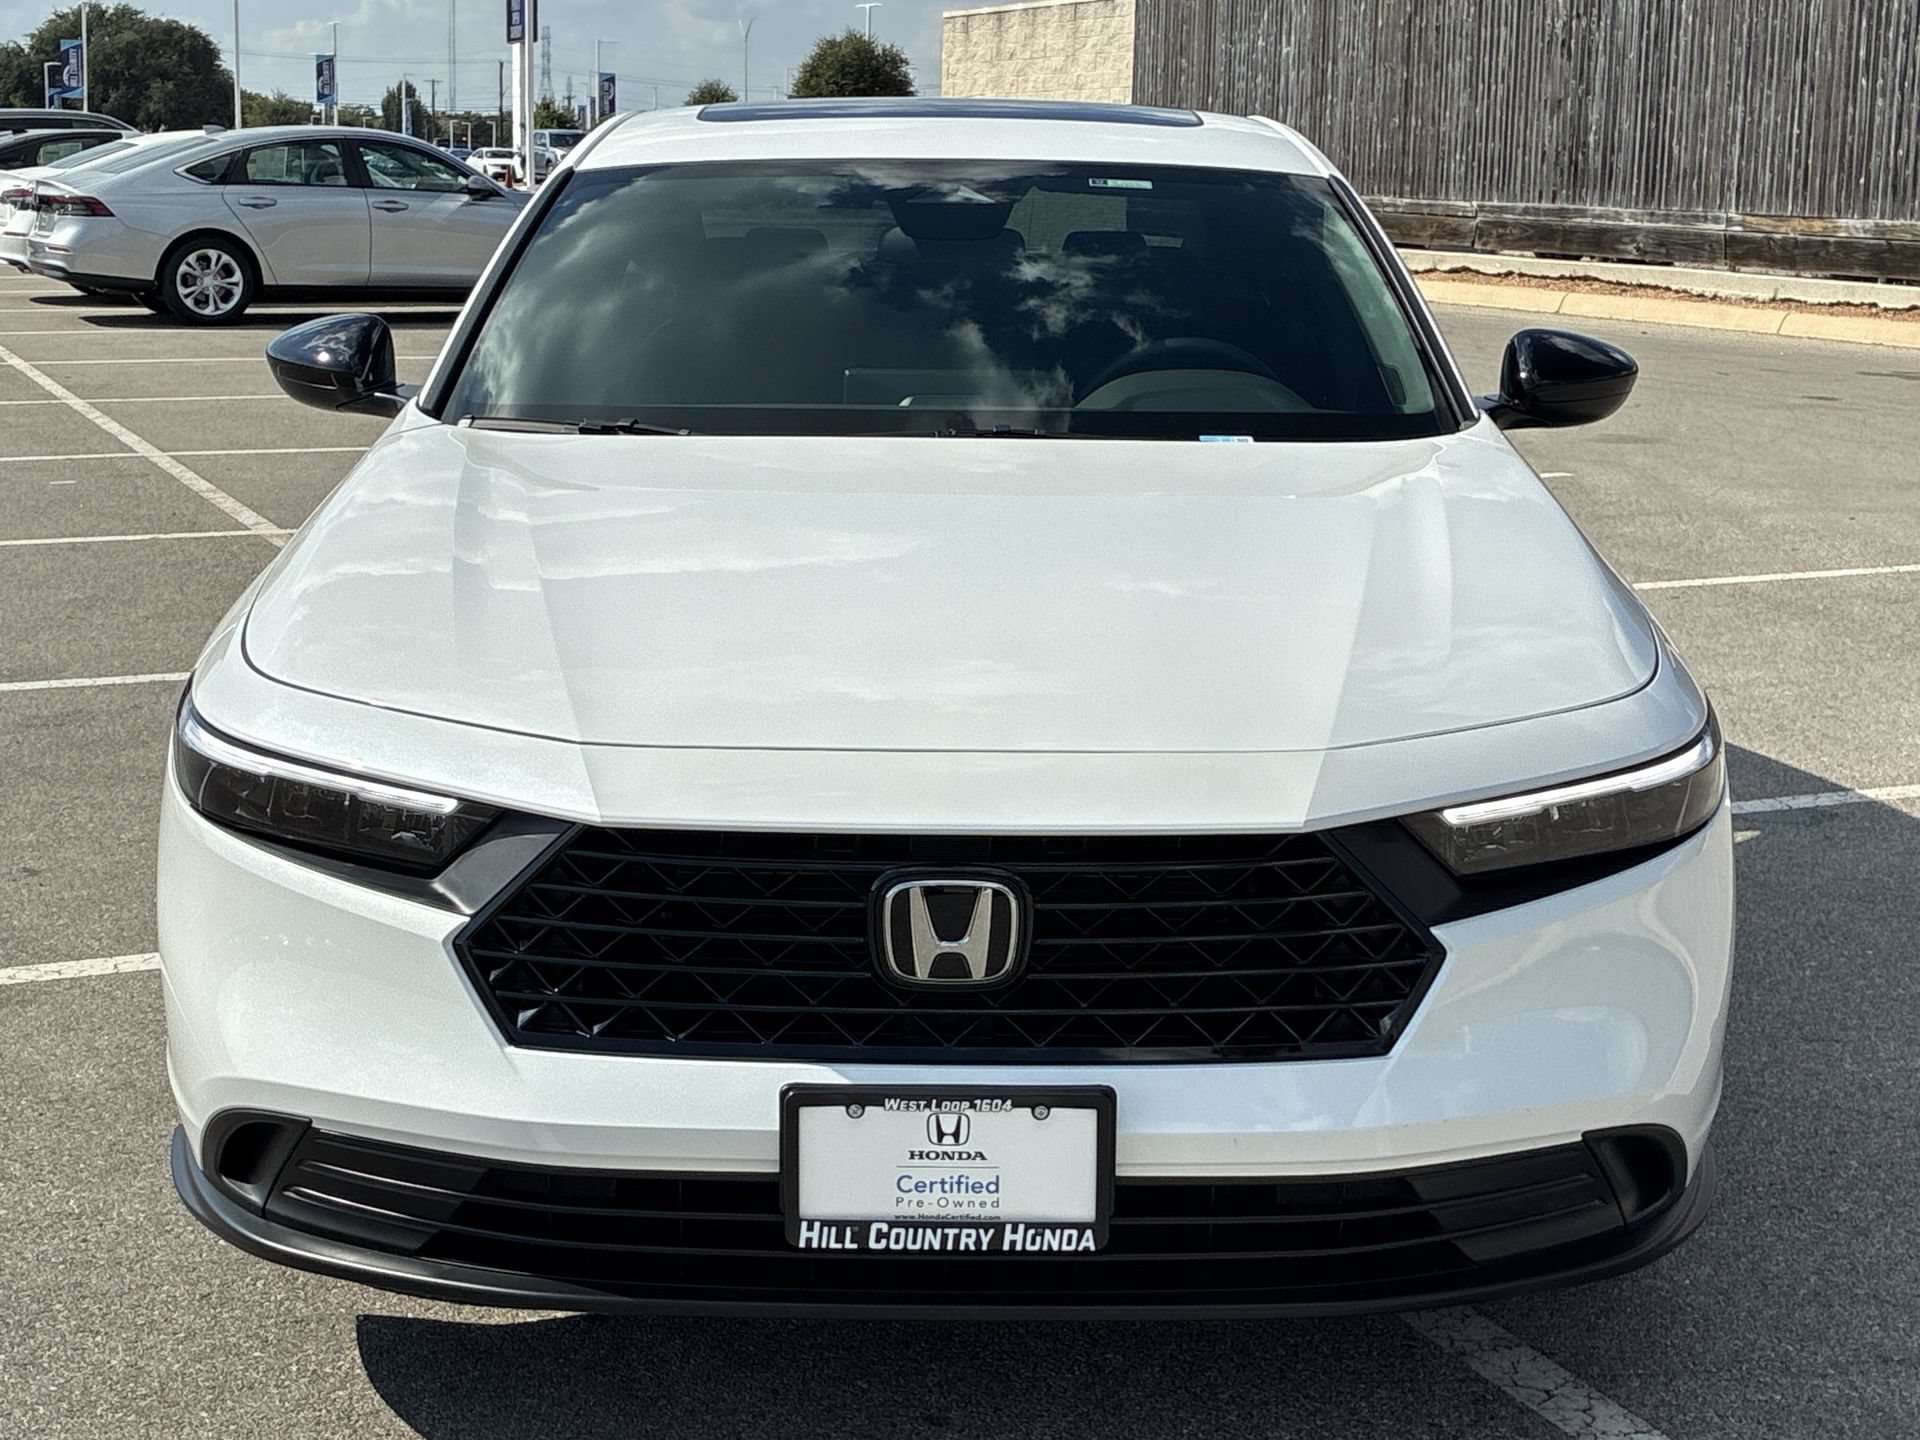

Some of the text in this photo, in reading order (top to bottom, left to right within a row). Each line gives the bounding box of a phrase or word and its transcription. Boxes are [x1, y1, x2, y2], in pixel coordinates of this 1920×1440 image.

[973, 1099, 1013, 1112] 1604
[908, 1150, 988, 1161] HONDA
[896, 1174, 1000, 1194] Certified
[895, 1196, 1000, 1208] Pre-Owned
[894, 1213, 1001, 1221] www.HondaCertified.com
[799, 1220, 858, 1249] HILL
[868, 1222, 995, 1250] COUNTRY
